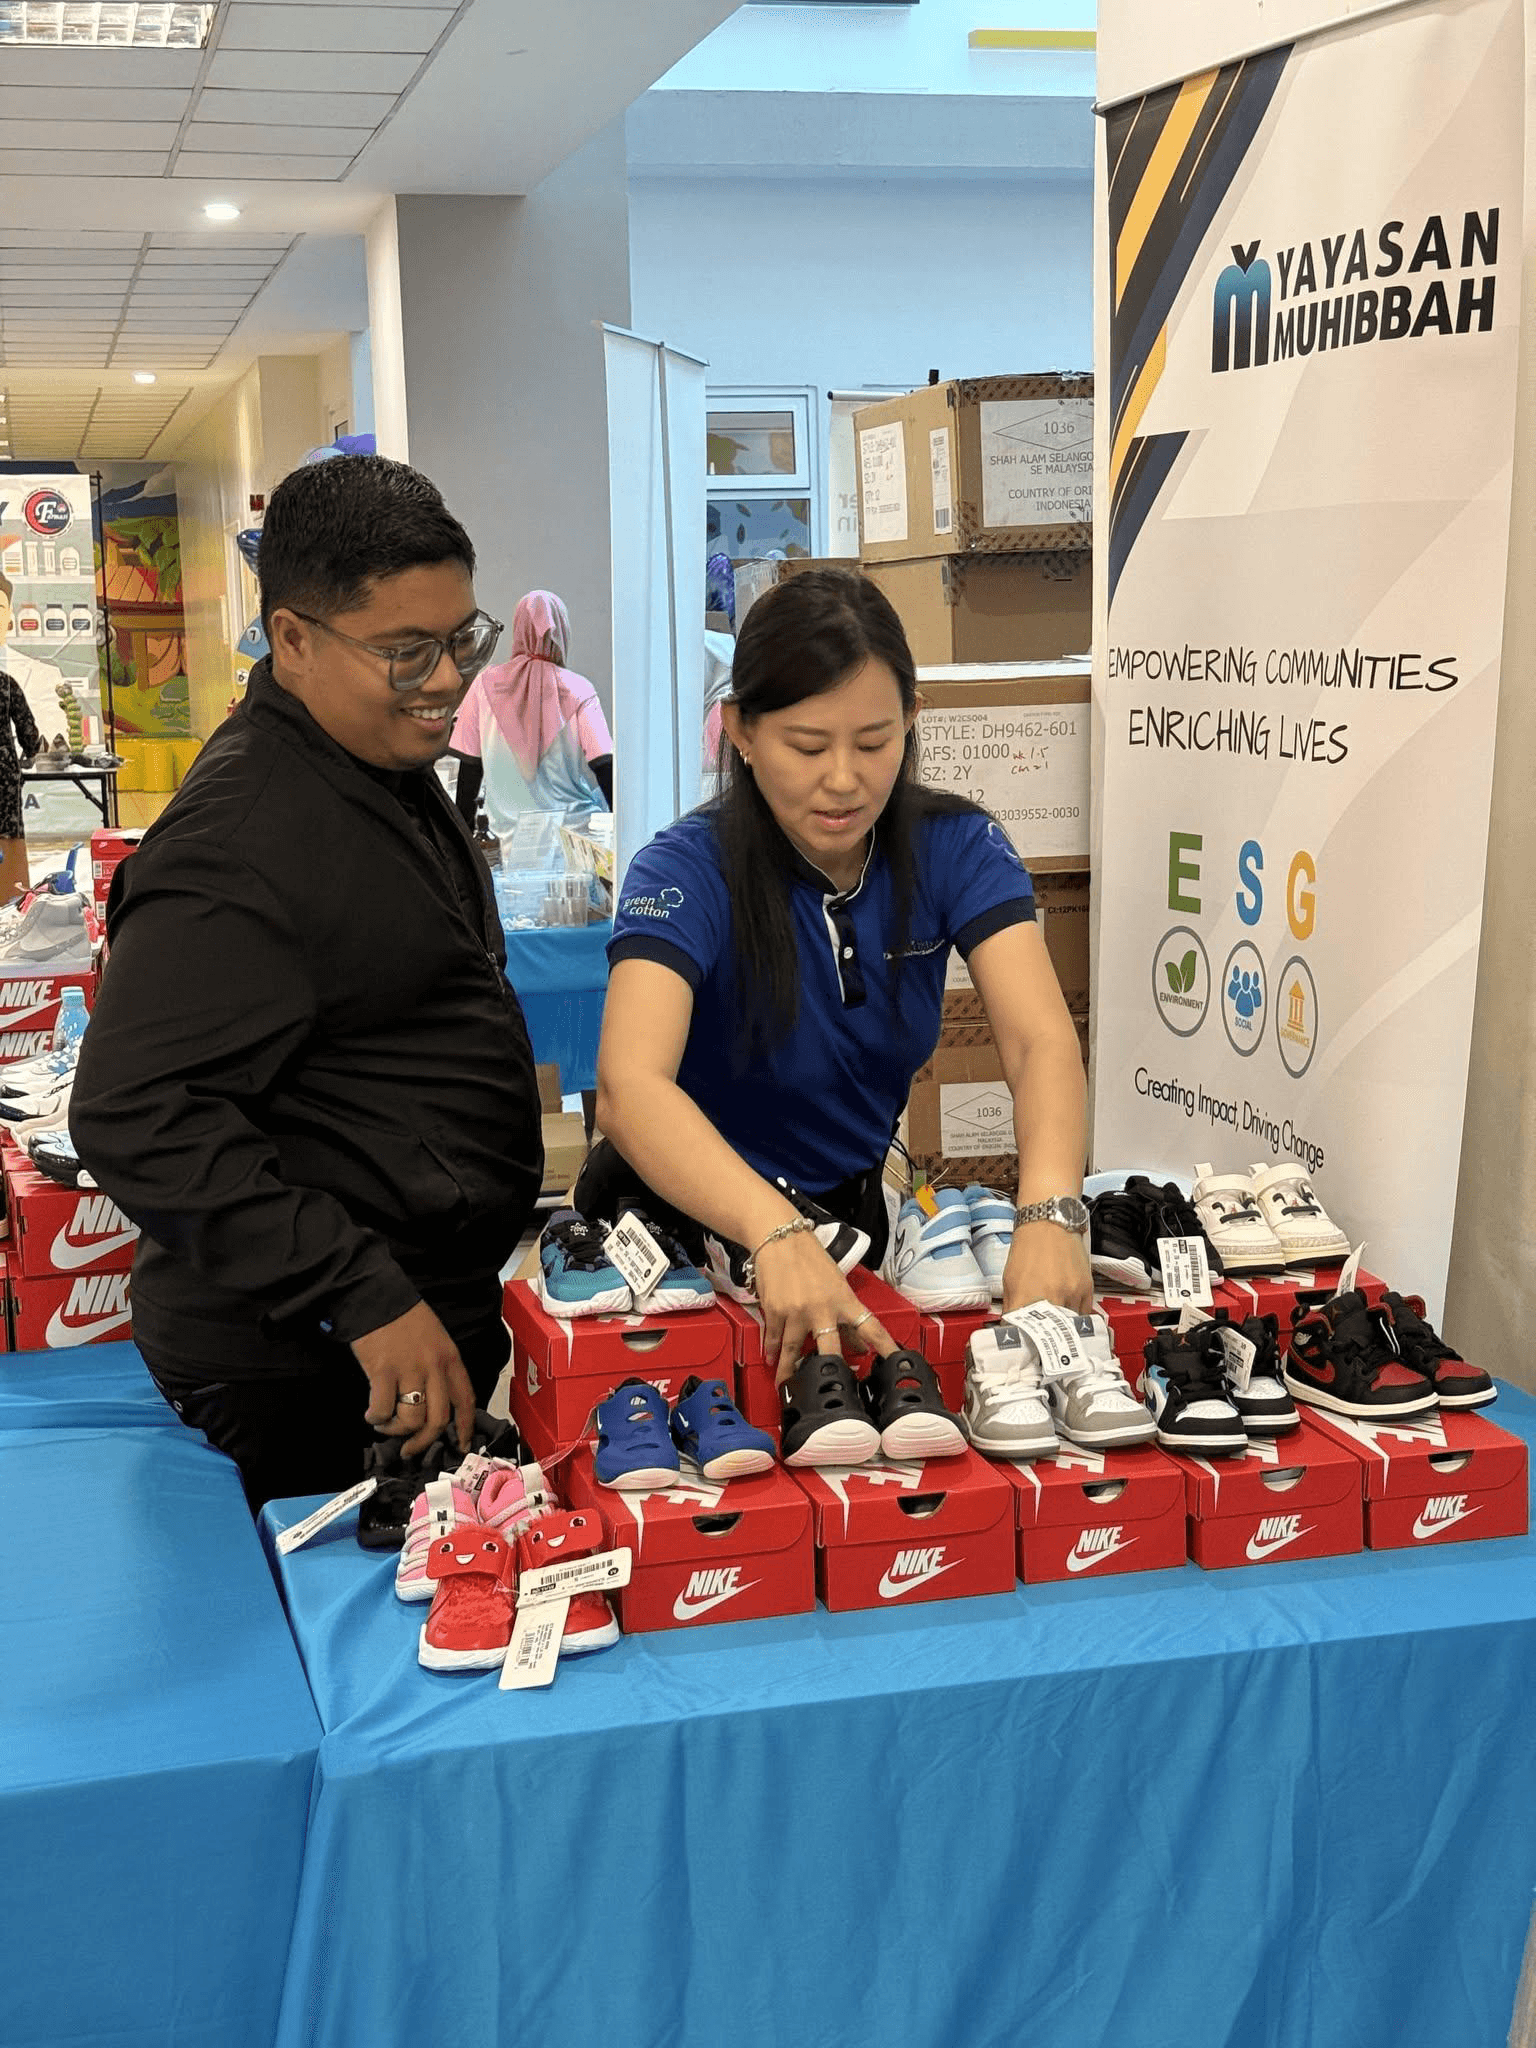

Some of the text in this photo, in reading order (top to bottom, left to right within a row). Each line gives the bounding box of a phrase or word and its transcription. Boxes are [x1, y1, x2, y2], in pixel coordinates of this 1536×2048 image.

[1276, 207, 1500, 302] YAYASAN
[1273, 276, 1496, 362] MUHIBBAH
[1044, 421, 1075, 435] 1036
[990, 455, 1017, 466] SHAH
[1020, 453, 1046, 464] ALAM
[1030, 462, 1093, 475] SE MALAYSIA
[1008, 487, 1056, 499] COUNTRY
[1058, 486, 1071, 497] OF
[1036, 499, 1091, 511] INDONESIA
[1108, 643, 1459, 692] EMPOWERING COMMUNITIES
[922, 721, 1077, 741] STYLE: DH9462-601
[1128, 705, 1349, 765] ENRICHING LIVES
[921, 743, 1010, 761] AFS: 01000
[921, 765, 973, 782] SZ: 2Y
[629, 904, 670, 919] cotton
[0, 979, 55, 1008] NIKE
[1159, 991, 1204, 1011] ENVIRONMENT
[0, 1031, 55, 1057] NIKE
[977, 1106, 1002, 1118] 1036
[1134, 1067, 1325, 1174] Creating Impact, Driving Change
[68, 1194, 136, 1236] NIK
[64, 1273, 132, 1317] NIK
[1422, 1494, 1469, 1520] NIKE
[1076, 1526, 1123, 1553] NIKE
[1255, 1514, 1303, 1541] NIKE
[892, 1547, 945, 1575] NIKE
[687, 1566, 743, 1597] NIKE
